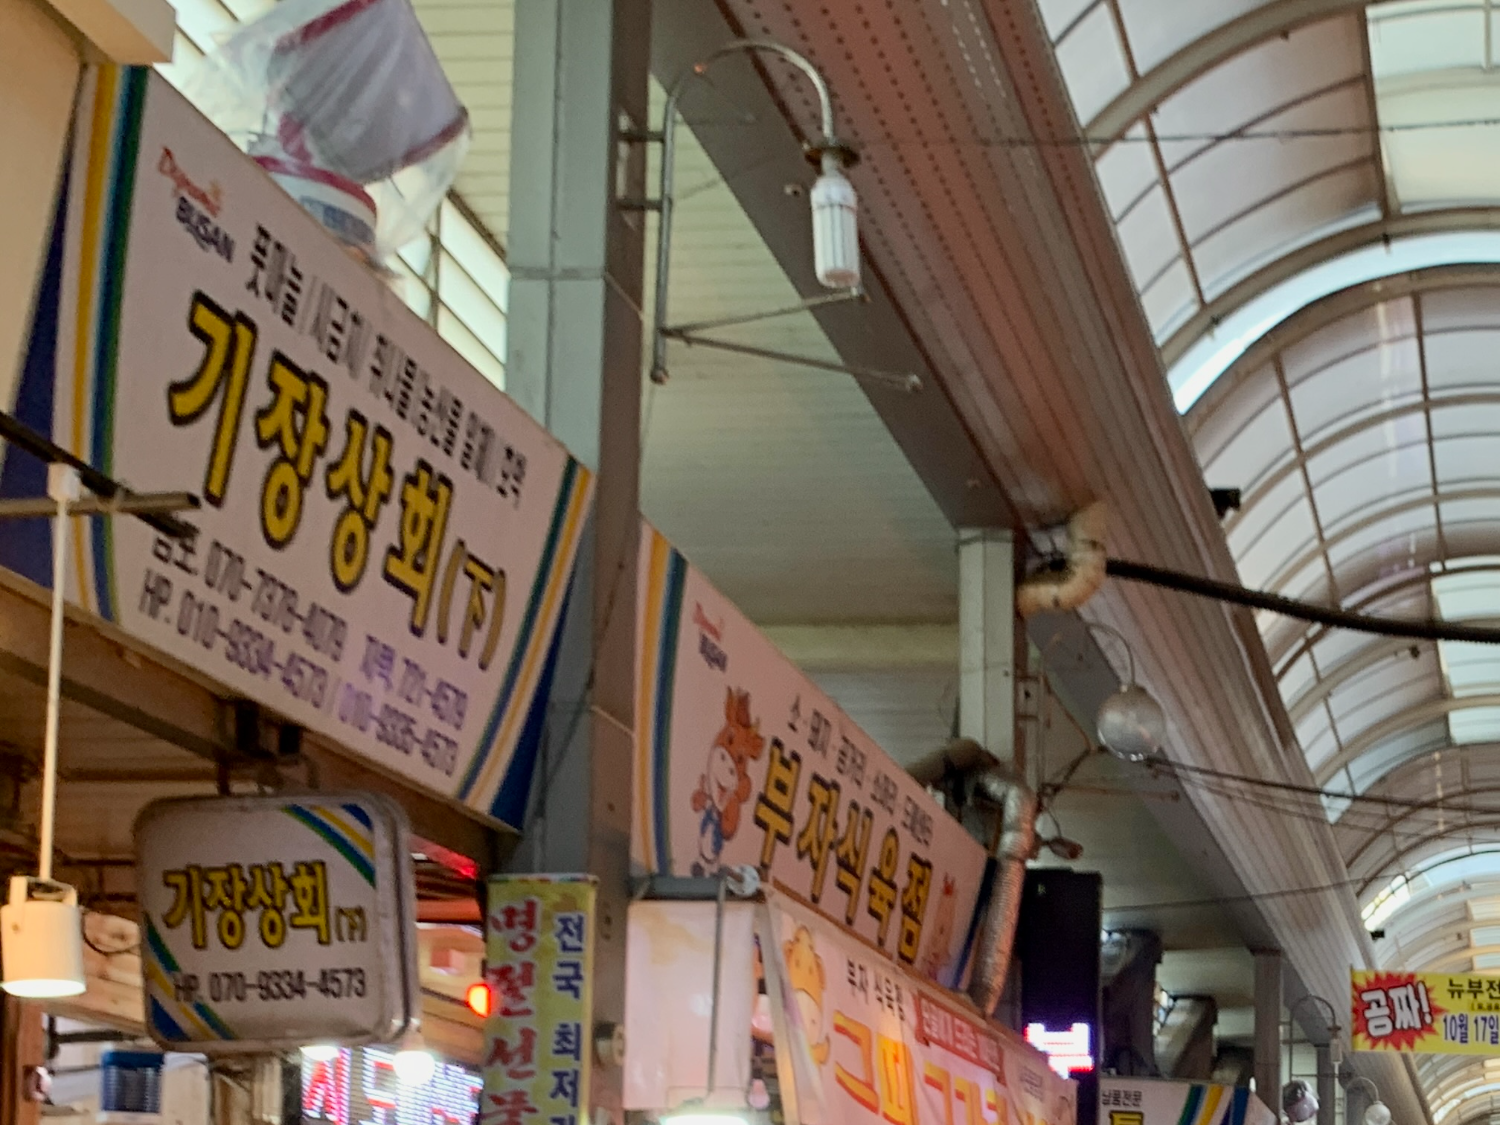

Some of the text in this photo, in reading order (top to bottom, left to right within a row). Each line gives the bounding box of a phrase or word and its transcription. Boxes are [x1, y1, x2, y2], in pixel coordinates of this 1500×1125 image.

[752, 735, 933, 967] 부자식육점
[553, 914, 585, 1001] 전국
[1360, 980, 1435, 1039] 공짜!
[1443, 1013, 1469, 1044] 10월
[1474, 1014, 1499, 1045] 17일
